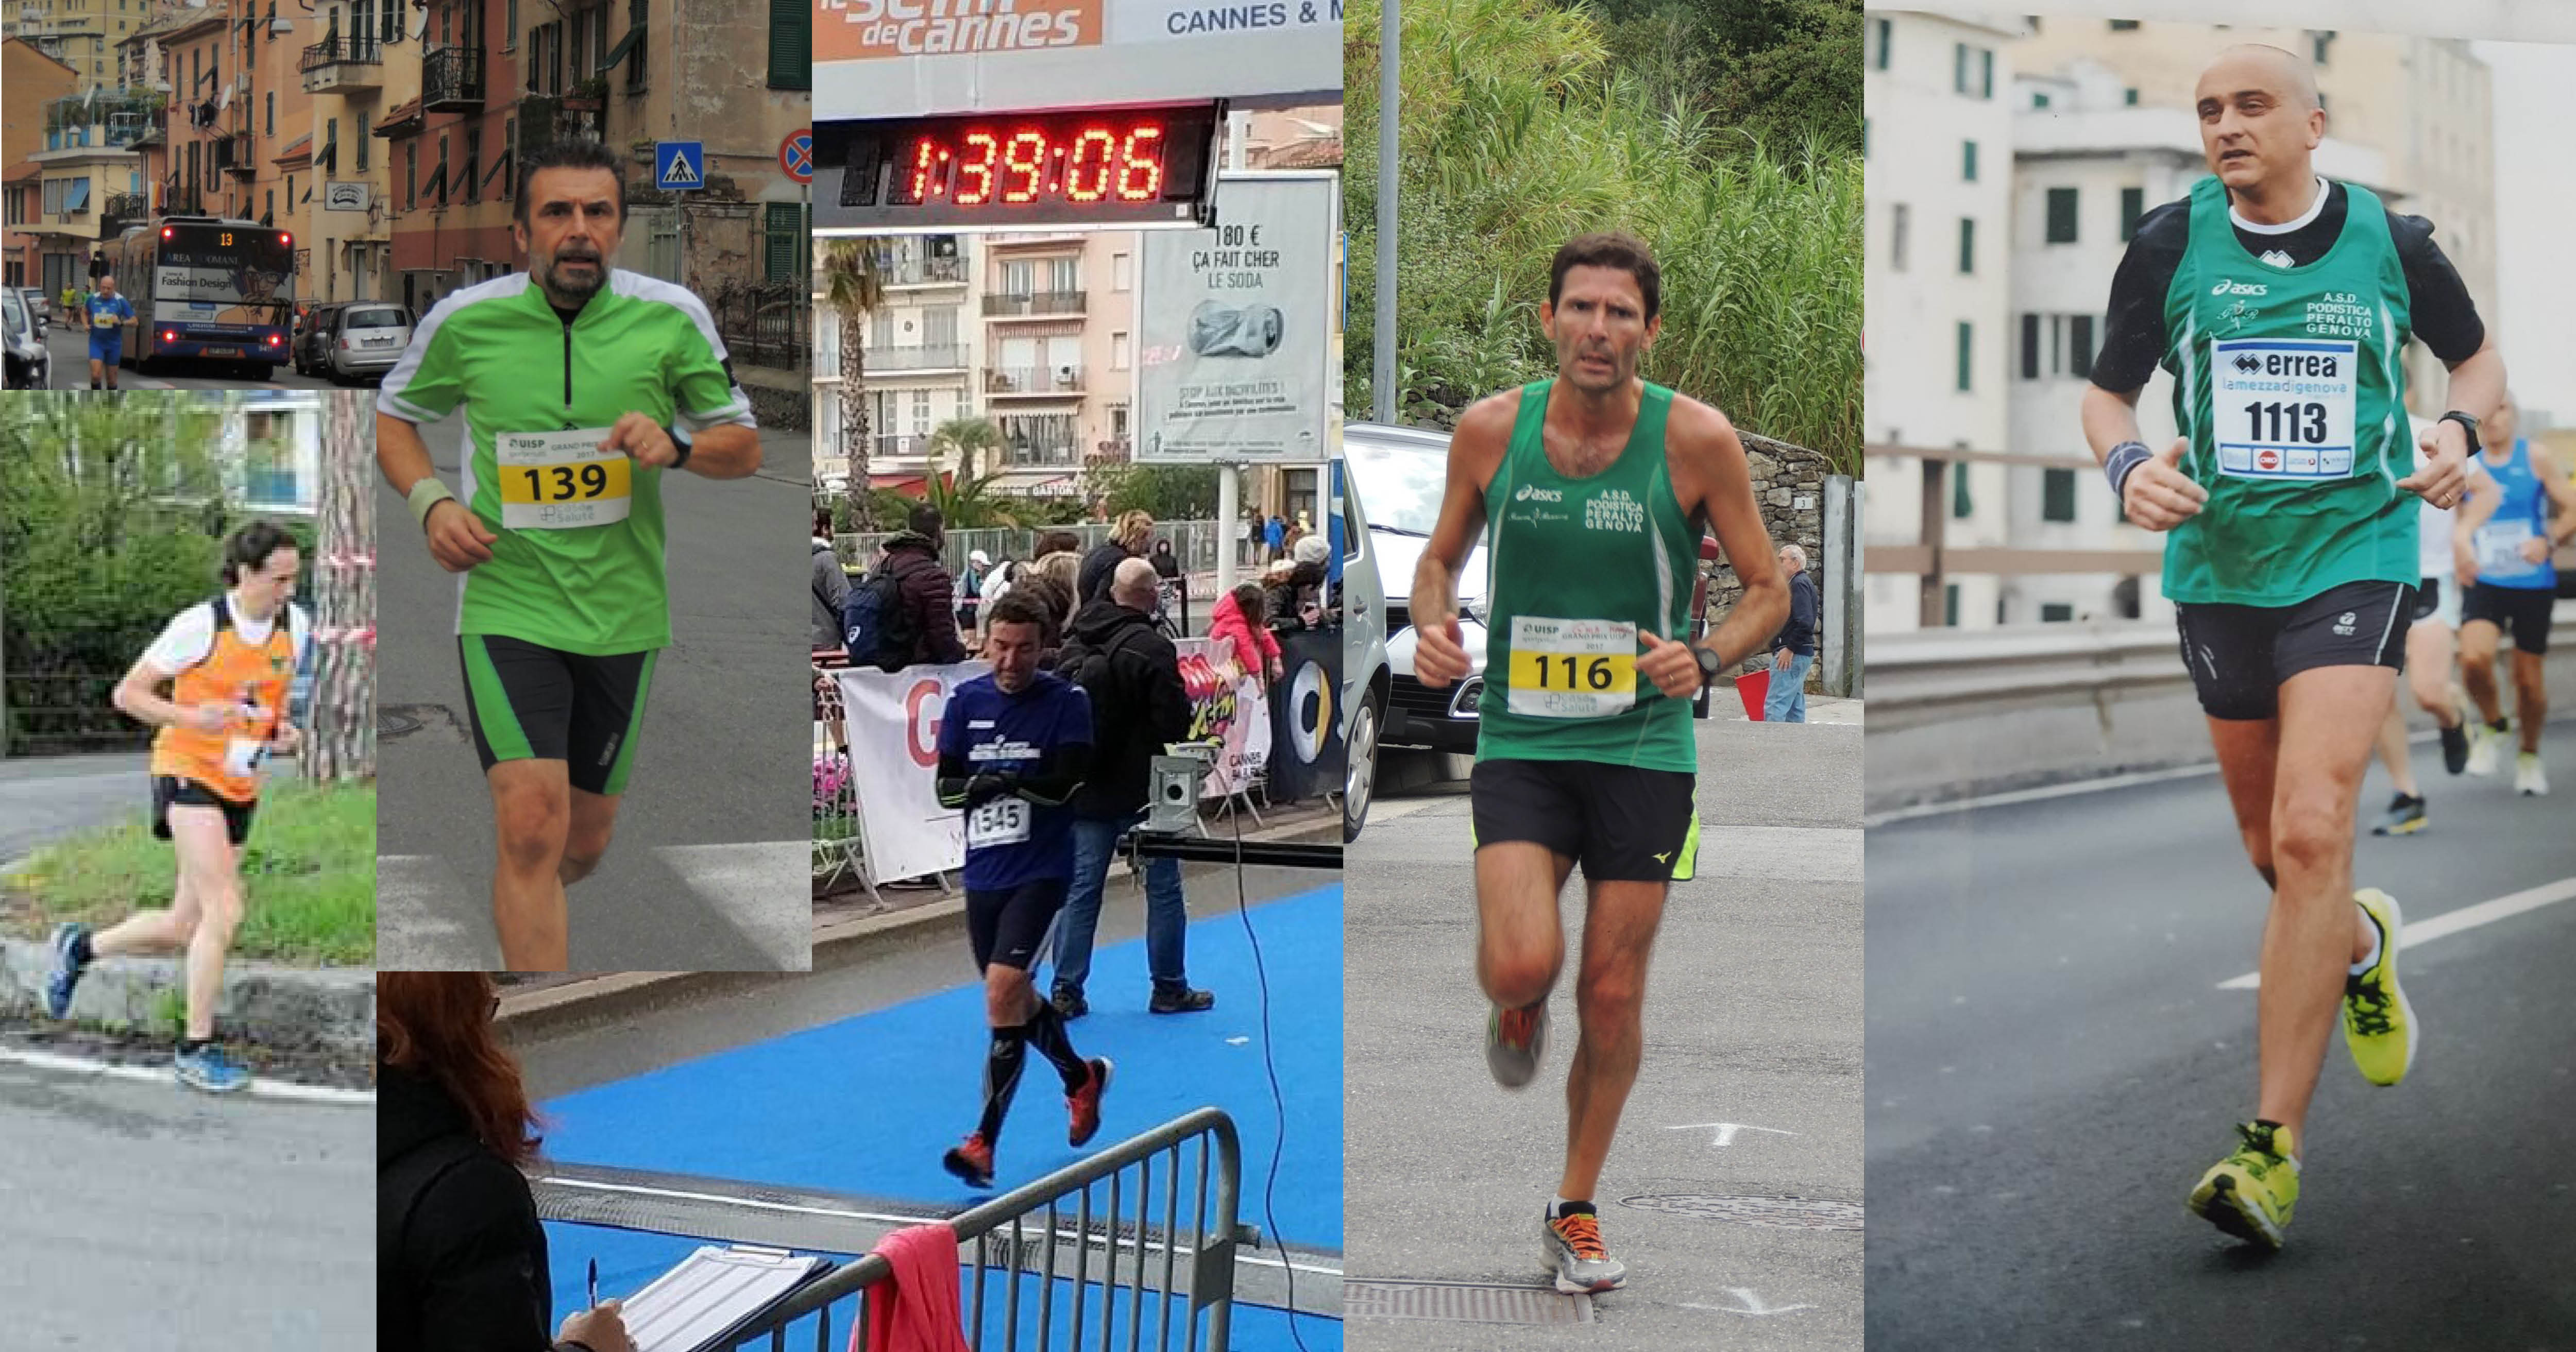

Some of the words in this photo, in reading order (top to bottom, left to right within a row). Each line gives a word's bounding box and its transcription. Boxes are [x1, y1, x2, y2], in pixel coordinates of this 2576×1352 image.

[1167, 3, 1286, 33] CANNES
[1299, 1, 1317, 23] &
[913, 128, 1160, 204] 1:39:06
[220, 233, 233, 246] 13
[1214, 225, 1244, 247] 180
[1250, 224, 1263, 247] €
[1193, 251, 1210, 273] ÇA
[1214, 250, 1240, 268] FAIT
[1245, 250, 1279, 268] CHER
[162, 276, 197, 287] Fashion
[199, 278, 231, 290] Design
[1208, 272, 1224, 288] LE
[1227, 271, 1263, 288] SODA
[2307, 302, 2372, 317] PODISTICA
[2306, 313, 2372, 328] PERALTO
[2307, 323, 2371, 338] GENOVA
[2223, 377, 2347, 395] lamezzadigenova
[2244, 401, 2328, 444] 1113
[519, 440, 545, 448] UISP
[551, 442, 580, 451] GRAND
[524, 464, 607, 501] 139
[1586, 498, 1644, 514] PODISTICA
[1801, 500, 1806, 508] 3
[1586, 508, 1643, 524] PERALTO
[1585, 519, 1642, 534] GENOVA
[1534, 624, 1560, 634] UISP
[1535, 655, 1613, 690] 116
